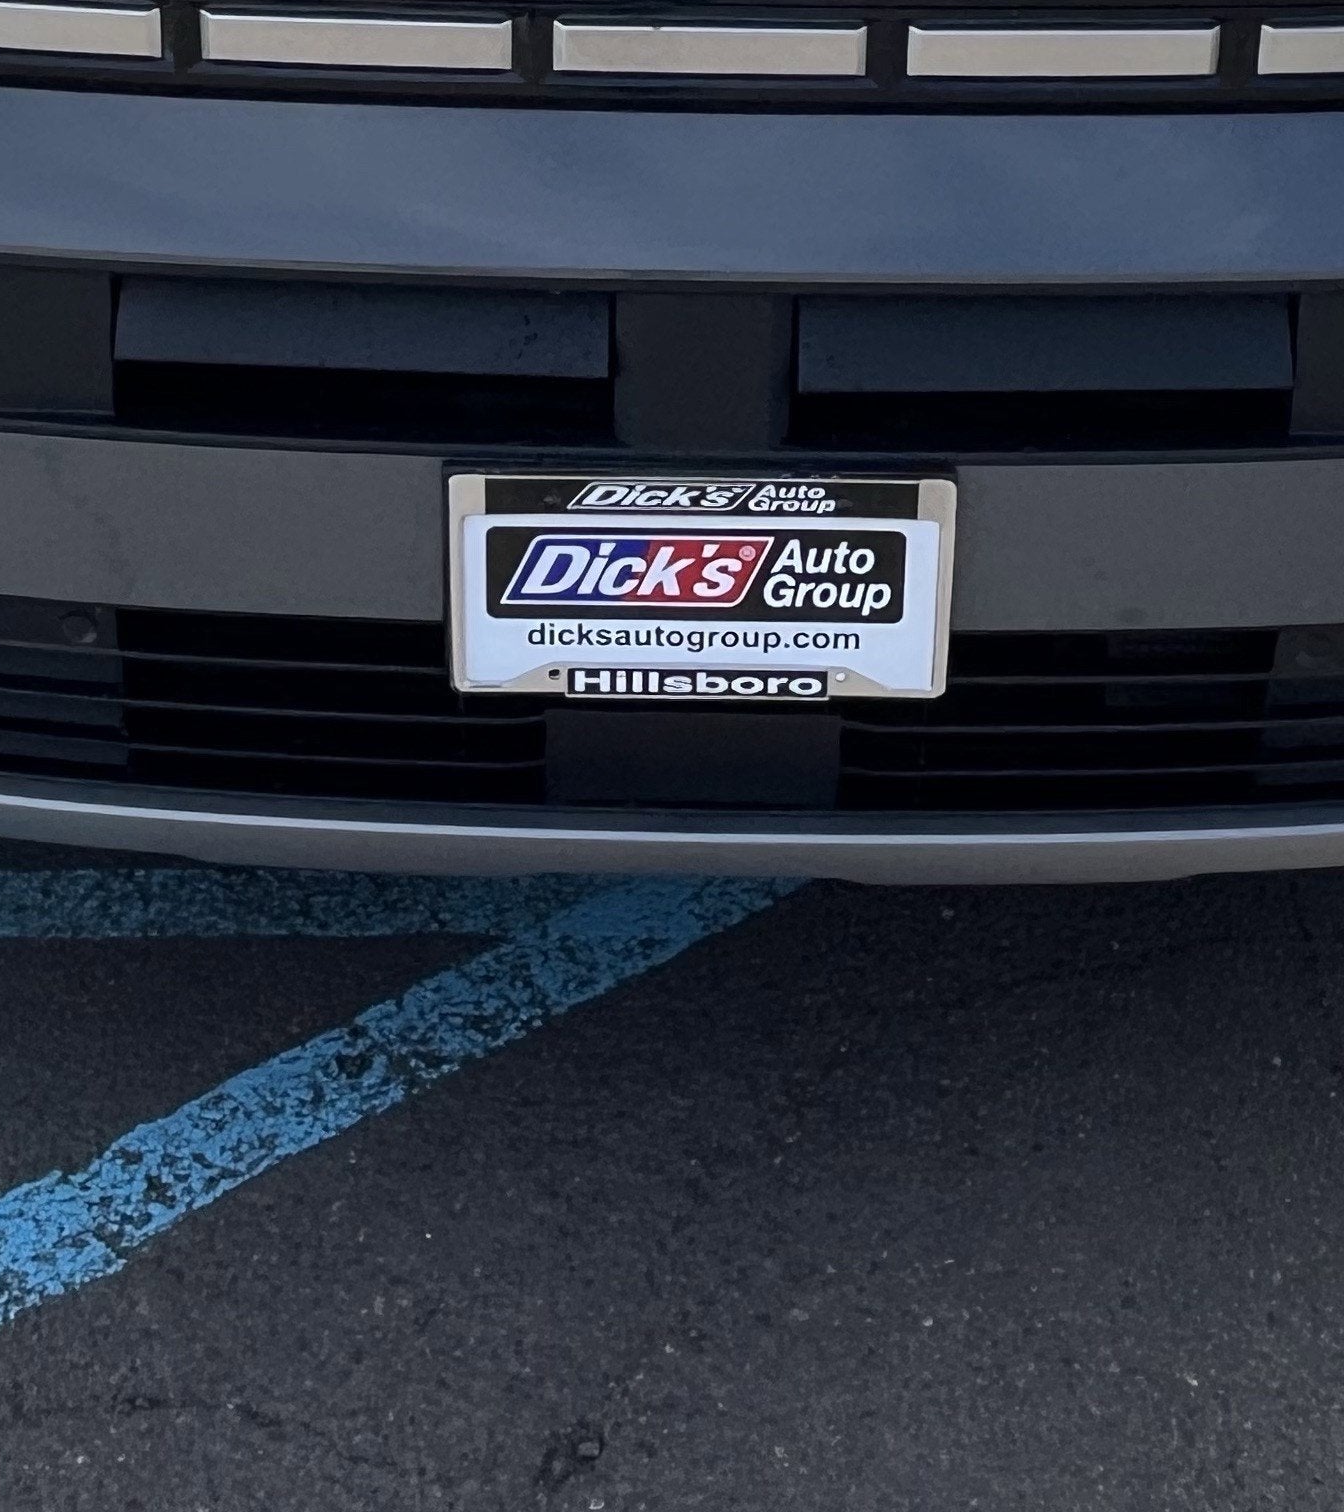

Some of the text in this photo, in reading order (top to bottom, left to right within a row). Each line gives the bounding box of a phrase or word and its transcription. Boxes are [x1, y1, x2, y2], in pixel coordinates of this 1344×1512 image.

[753, 483, 826, 499] Auto
[748, 496, 837, 515] Group
[770, 538, 876, 575] Auto
[762, 573, 893, 616] Group
[526, 622, 861, 653] dicksautogroup.com
[573, 670, 824, 696] Hillsboro
